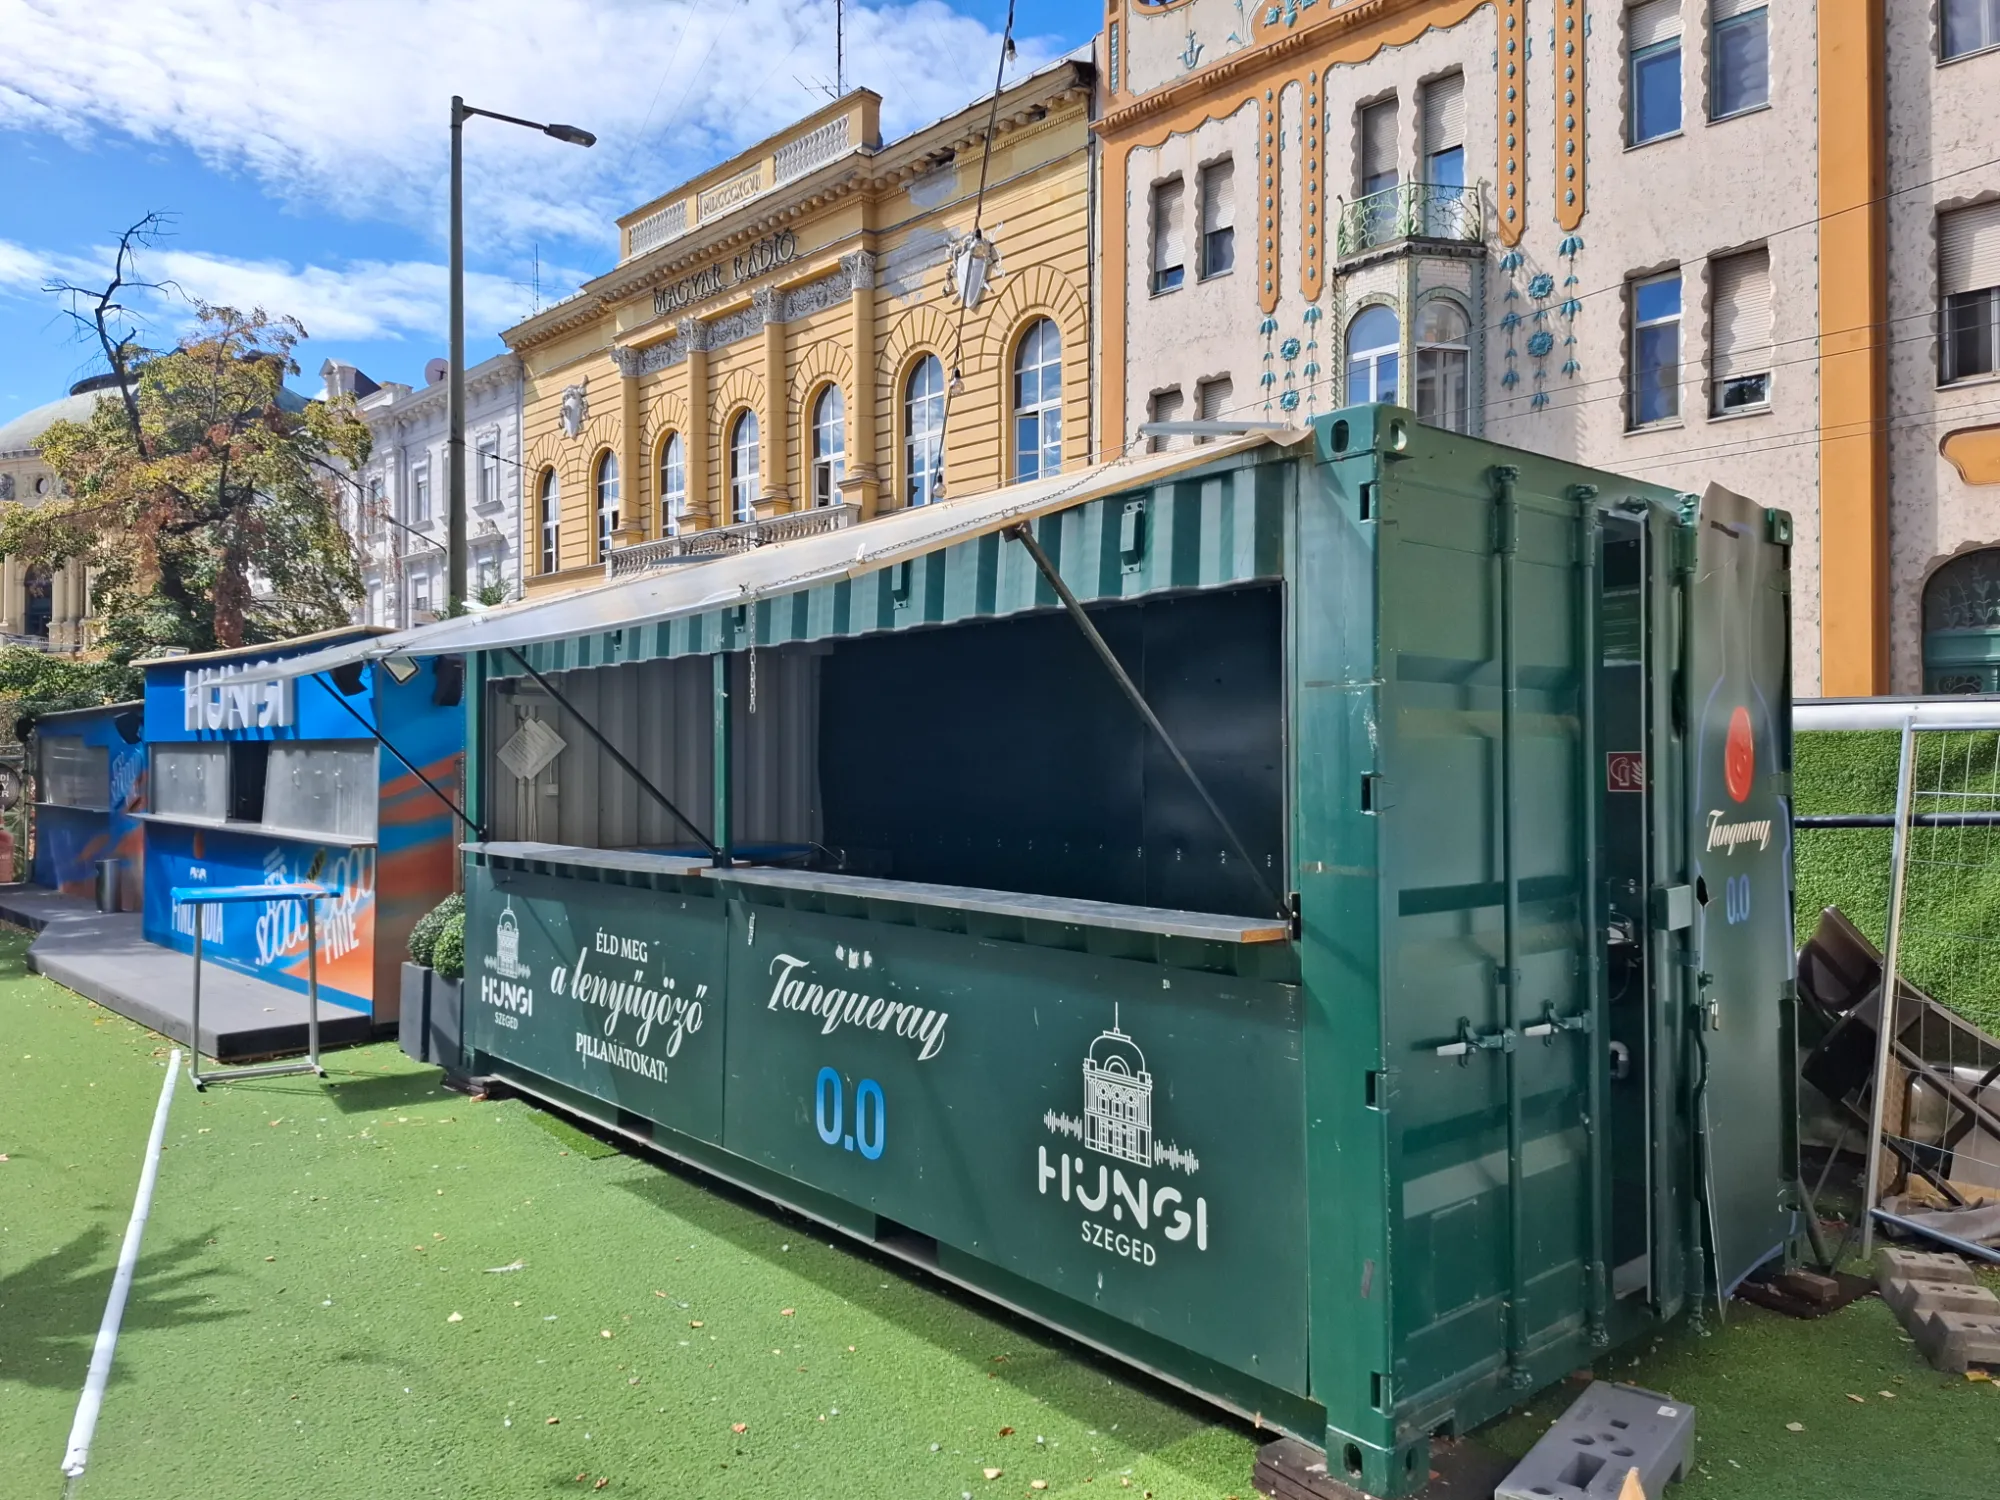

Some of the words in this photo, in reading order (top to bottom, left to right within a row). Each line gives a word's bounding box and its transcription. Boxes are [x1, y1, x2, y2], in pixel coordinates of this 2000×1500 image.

[653, 263, 724, 316] MAGYAR
[184, 657, 293, 732] HUNGI
[1706, 809, 1771, 856] Tanqueray
[1727, 873, 1750, 925] 0.0
[323, 910, 359, 965] FINE
[596, 926, 619, 956] ÉLD
[620, 937, 648, 963] MEG
[481, 975, 533, 1017] HUNGI
[494, 1011, 519, 1030] SZEGED
[550, 965, 568, 995] a
[571, 946, 708, 1058] lenyűgöző
[767, 953, 949, 1061] Tanqueray
[575, 1032, 668, 1084] PILLANATOKAT!
[816, 1066, 885, 1160] 0.0
[1038, 1145, 1207, 1251] HUNGI
[1081, 1220, 1156, 1267] SZEGED
